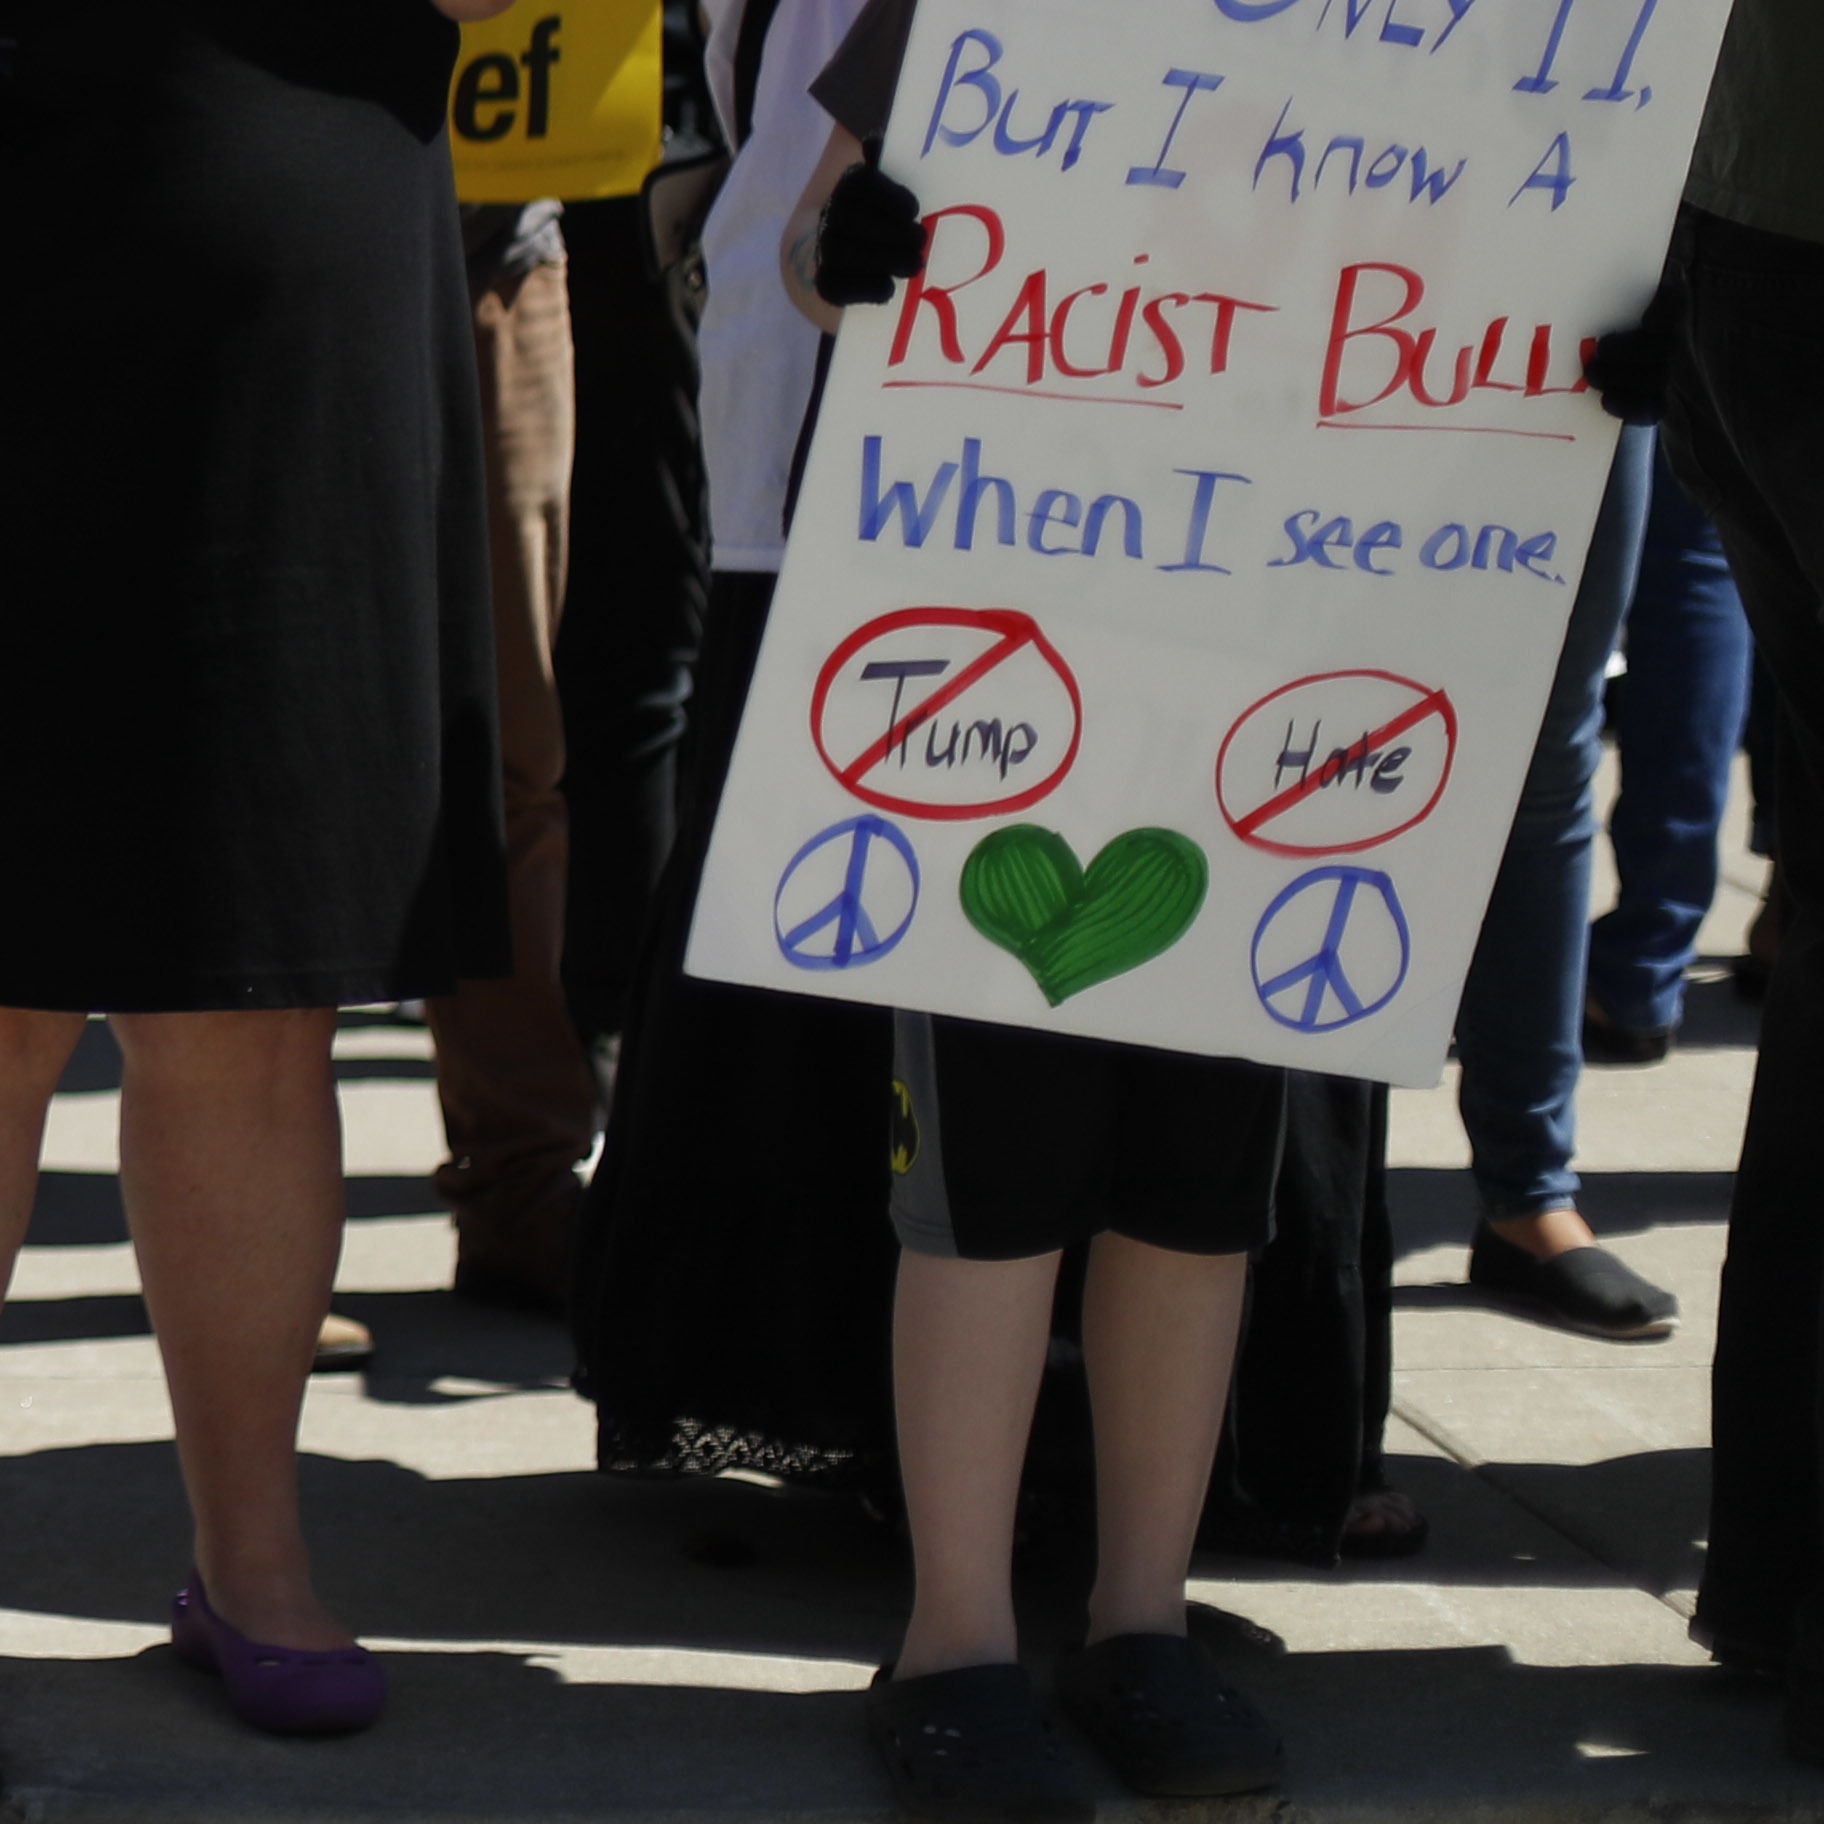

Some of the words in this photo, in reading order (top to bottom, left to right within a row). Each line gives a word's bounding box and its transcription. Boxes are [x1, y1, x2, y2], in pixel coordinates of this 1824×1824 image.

[1125, 67, 1225, 189] I
[1253, 96, 1470, 208] know
[1507, 130, 1577, 211] A
[1318, 262, 1596, 419] BULL
[860, 434, 1144, 564] When
[1156, 468, 1252, 576] I
[1266, 509, 1402, 576] see
[860, 659, 1039, 782] Trump
[1273, 717, 1413, 795] Hate
